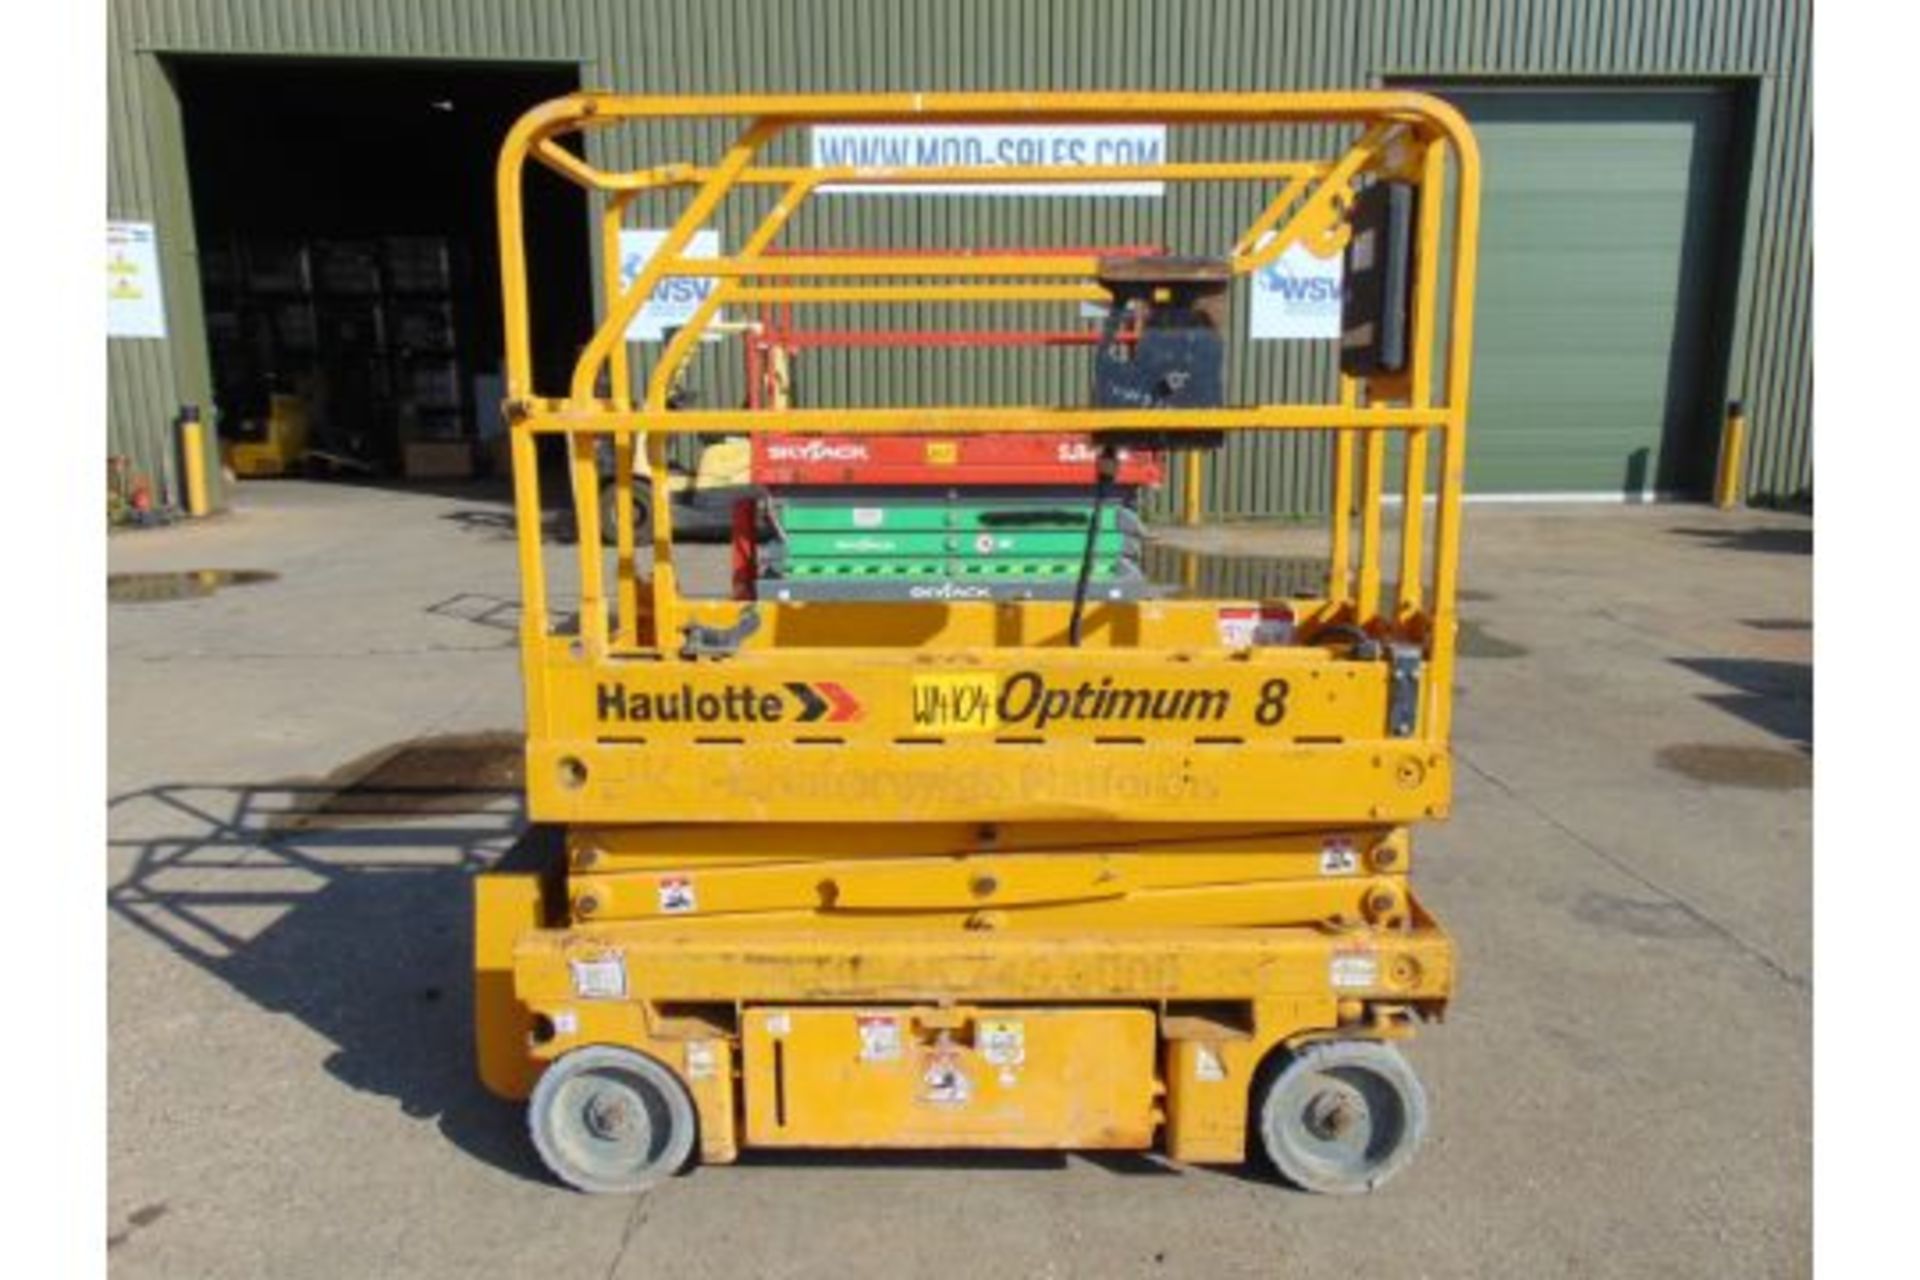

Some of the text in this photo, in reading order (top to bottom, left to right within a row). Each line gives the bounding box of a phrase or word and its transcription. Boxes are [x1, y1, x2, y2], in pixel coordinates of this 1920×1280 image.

[819, 136, 1161, 166] WWWMOD-SALESCOM
[597, 682, 784, 723] Haulotte
[998, 671, 1290, 729] Optimum 8
